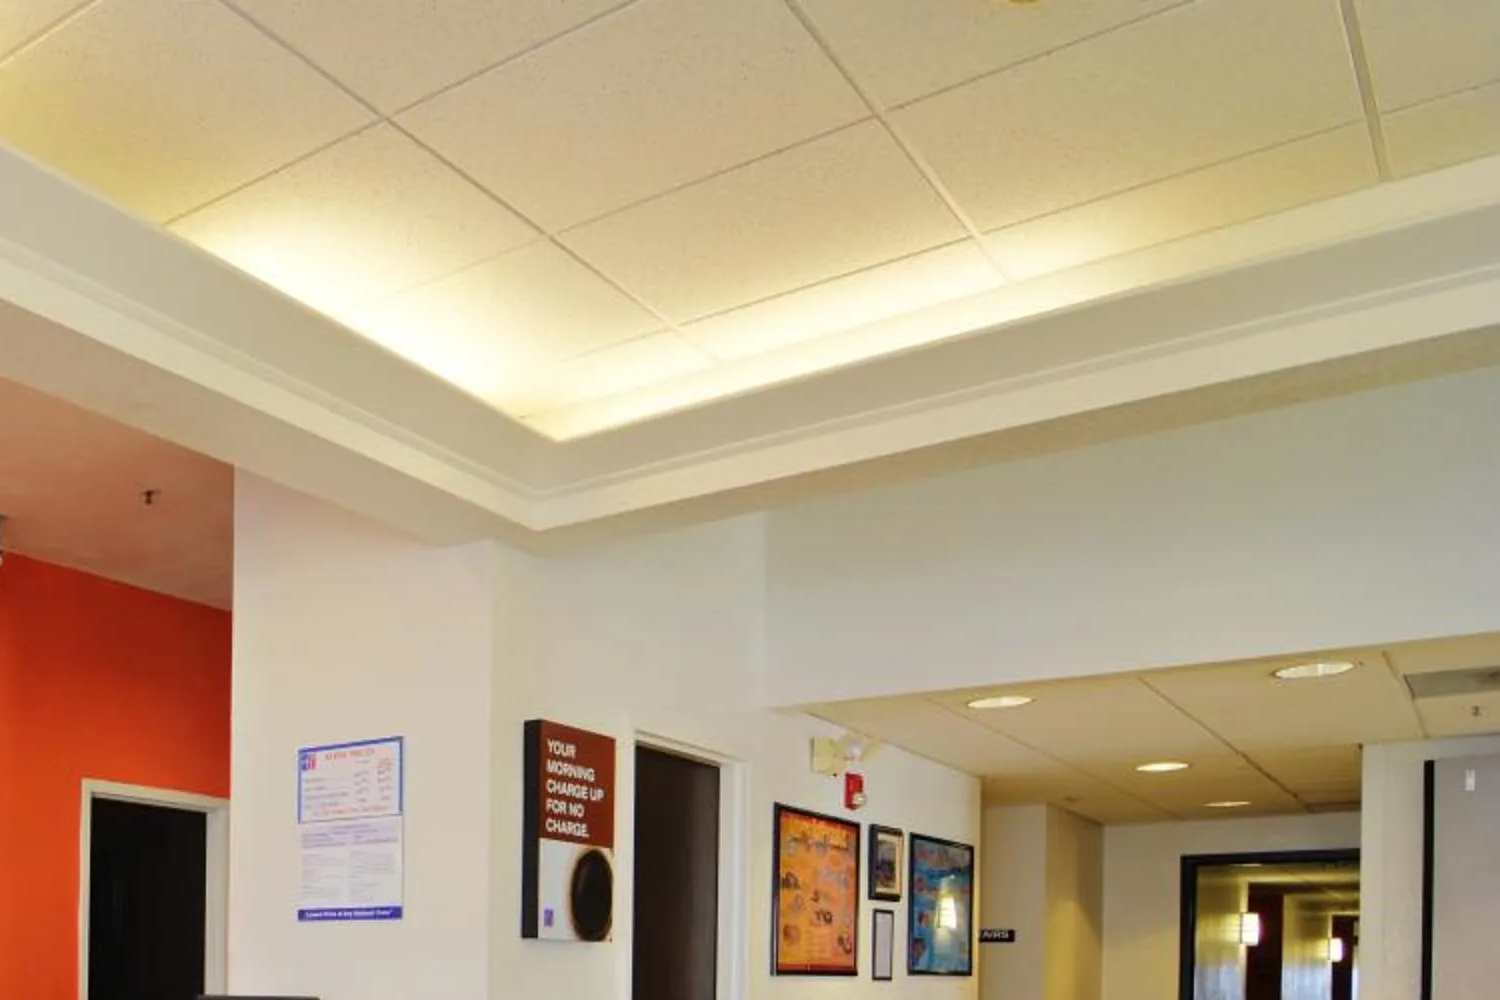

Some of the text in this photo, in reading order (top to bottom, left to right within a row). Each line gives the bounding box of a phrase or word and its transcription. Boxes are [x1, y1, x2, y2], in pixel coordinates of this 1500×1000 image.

[547, 738, 576, 758] YOUR
[546, 759, 594, 782] MORNING
[546, 779, 604, 801] CHARGE UP
[546, 798, 584, 818] FOR NO
[546, 818, 589, 837] CHARGE.
